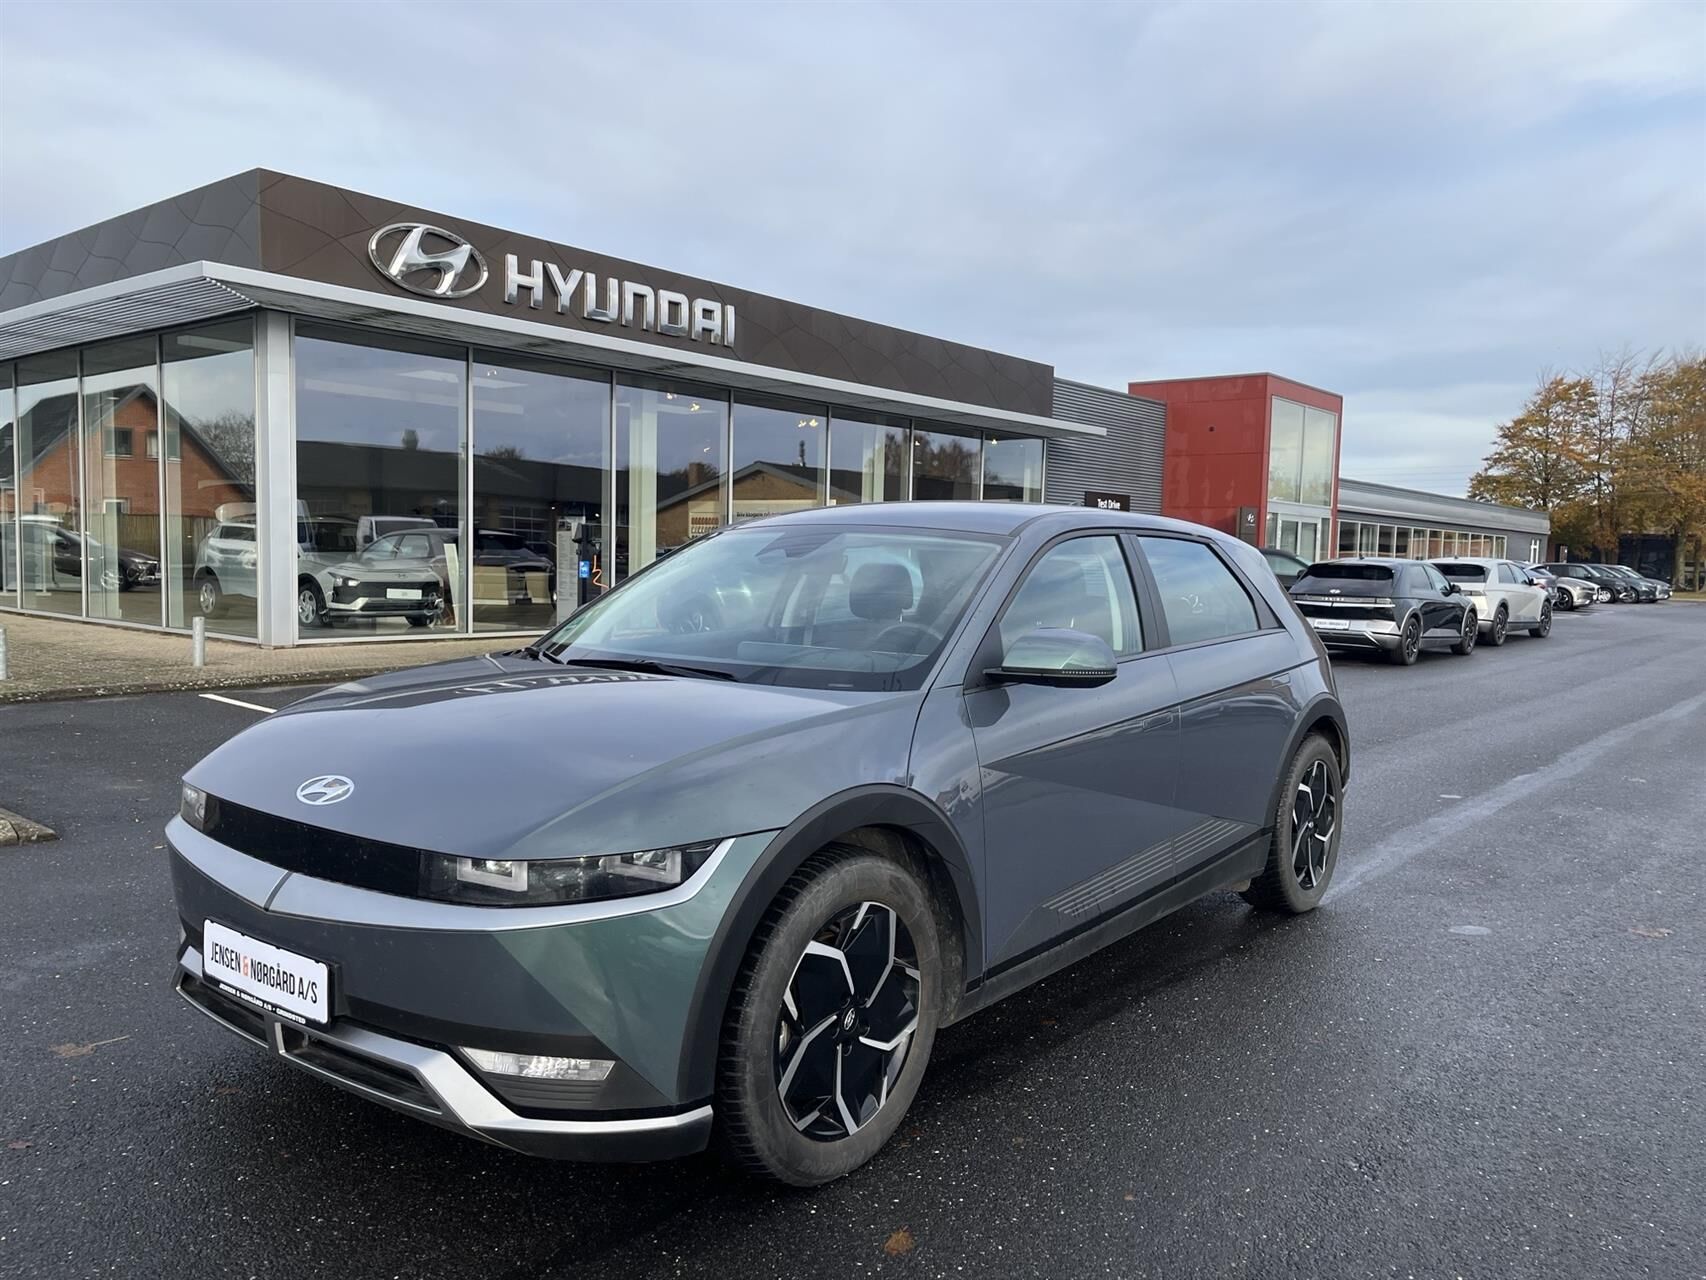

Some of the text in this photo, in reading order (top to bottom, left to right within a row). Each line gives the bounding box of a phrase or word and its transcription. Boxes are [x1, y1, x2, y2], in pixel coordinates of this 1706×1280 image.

[504, 253, 735, 347] HYUNDAI
[1097, 498, 1120, 510] Test Drive
[211, 941, 318, 1004] JENSEN & NØRGÅRD A/S
